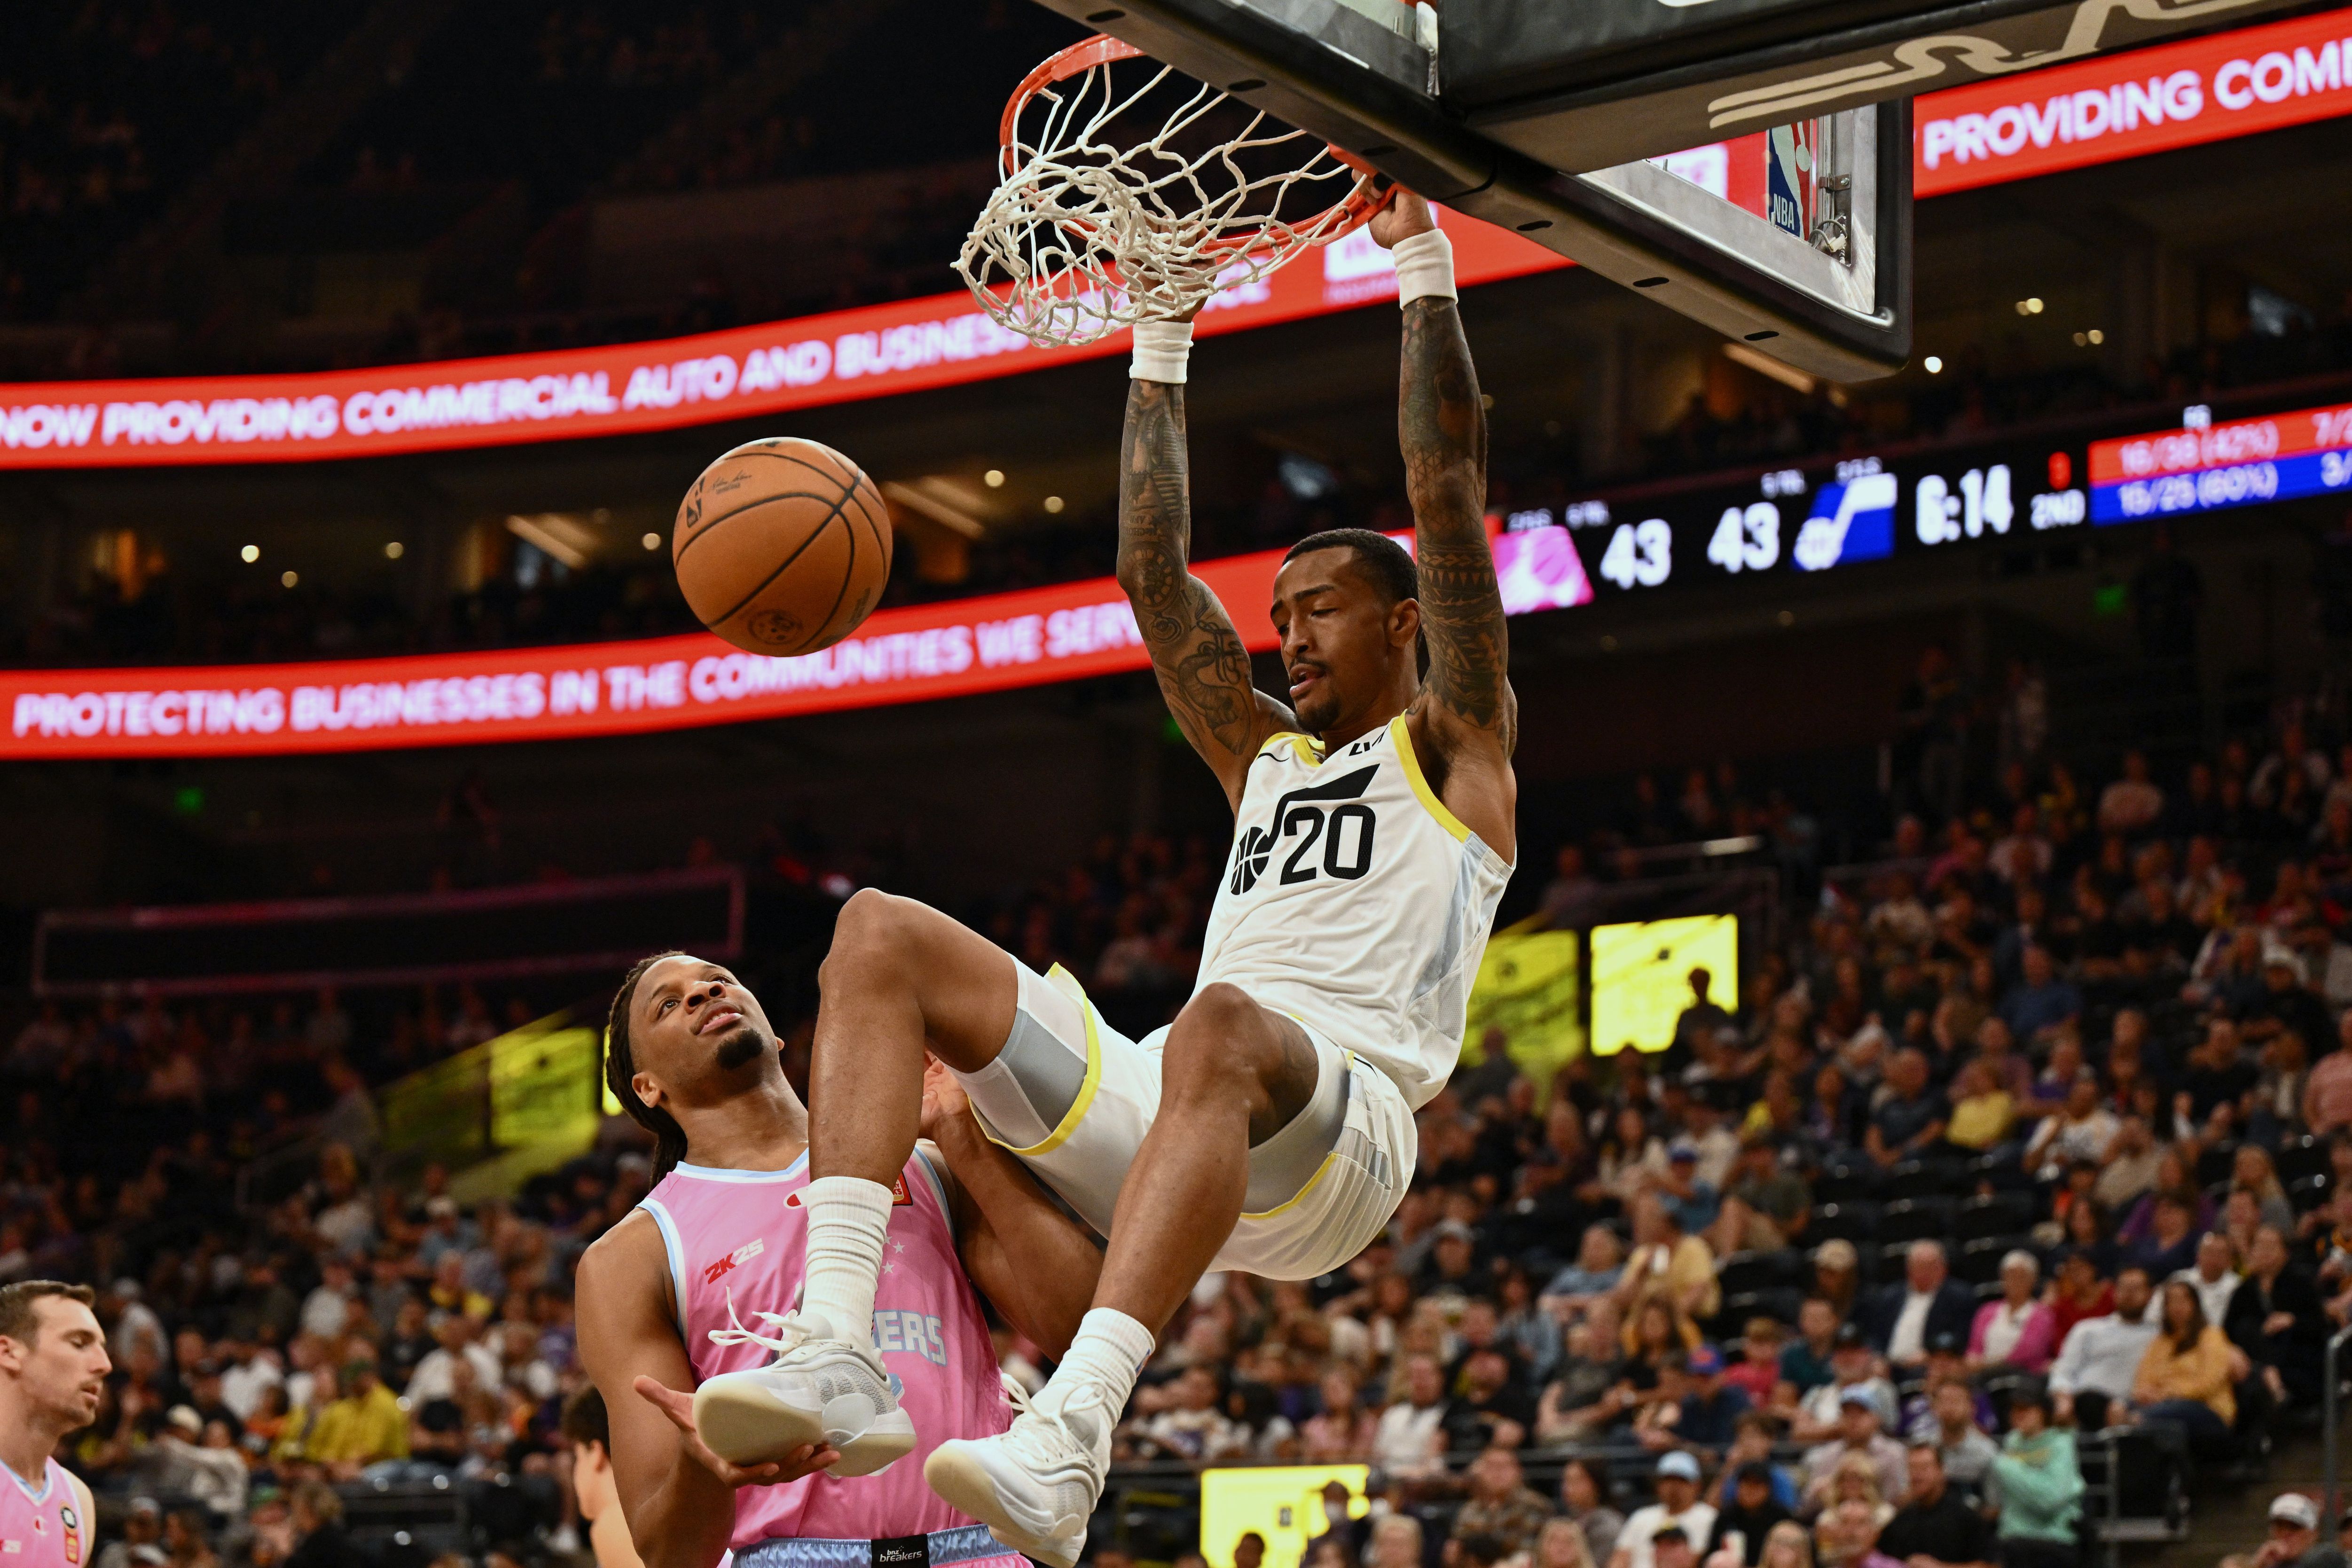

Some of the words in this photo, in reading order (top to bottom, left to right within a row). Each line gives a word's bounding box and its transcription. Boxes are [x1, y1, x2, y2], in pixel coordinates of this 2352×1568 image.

[1923, 70, 2204, 170] PROVIDING
[2213, 37, 2352, 110] COM
[1773, 193, 1795, 231] NBA
[0, 404, 99, 448] NOW
[101, 395, 339, 446] PROVIDING
[343, 372, 618, 435] COMMERCIAL
[621, 355, 738, 410] AUTO
[738, 340, 832, 394] AND
[1707, 502, 1780, 573] 43
[1916, 464, 2014, 545] 6:14
[2031, 489, 2085, 530] 2ND
[1600, 518, 1672, 589] 43
[13, 688, 284, 737] PROTECTING
[290, 672, 546, 731] BUSINESSES
[550, 670, 599, 714] IN
[604, 660, 687, 711] THE
[689, 626, 973, 701] COMMUNITIES
[975, 614, 1043, 667] WE
[1045, 600, 1145, 658] SERV
[1279, 804, 1376, 886] 20
[705, 1237, 764, 1285] 2K25
[872, 1309, 948, 1367] ERS
[879, 1551, 922, 1562] breakers
